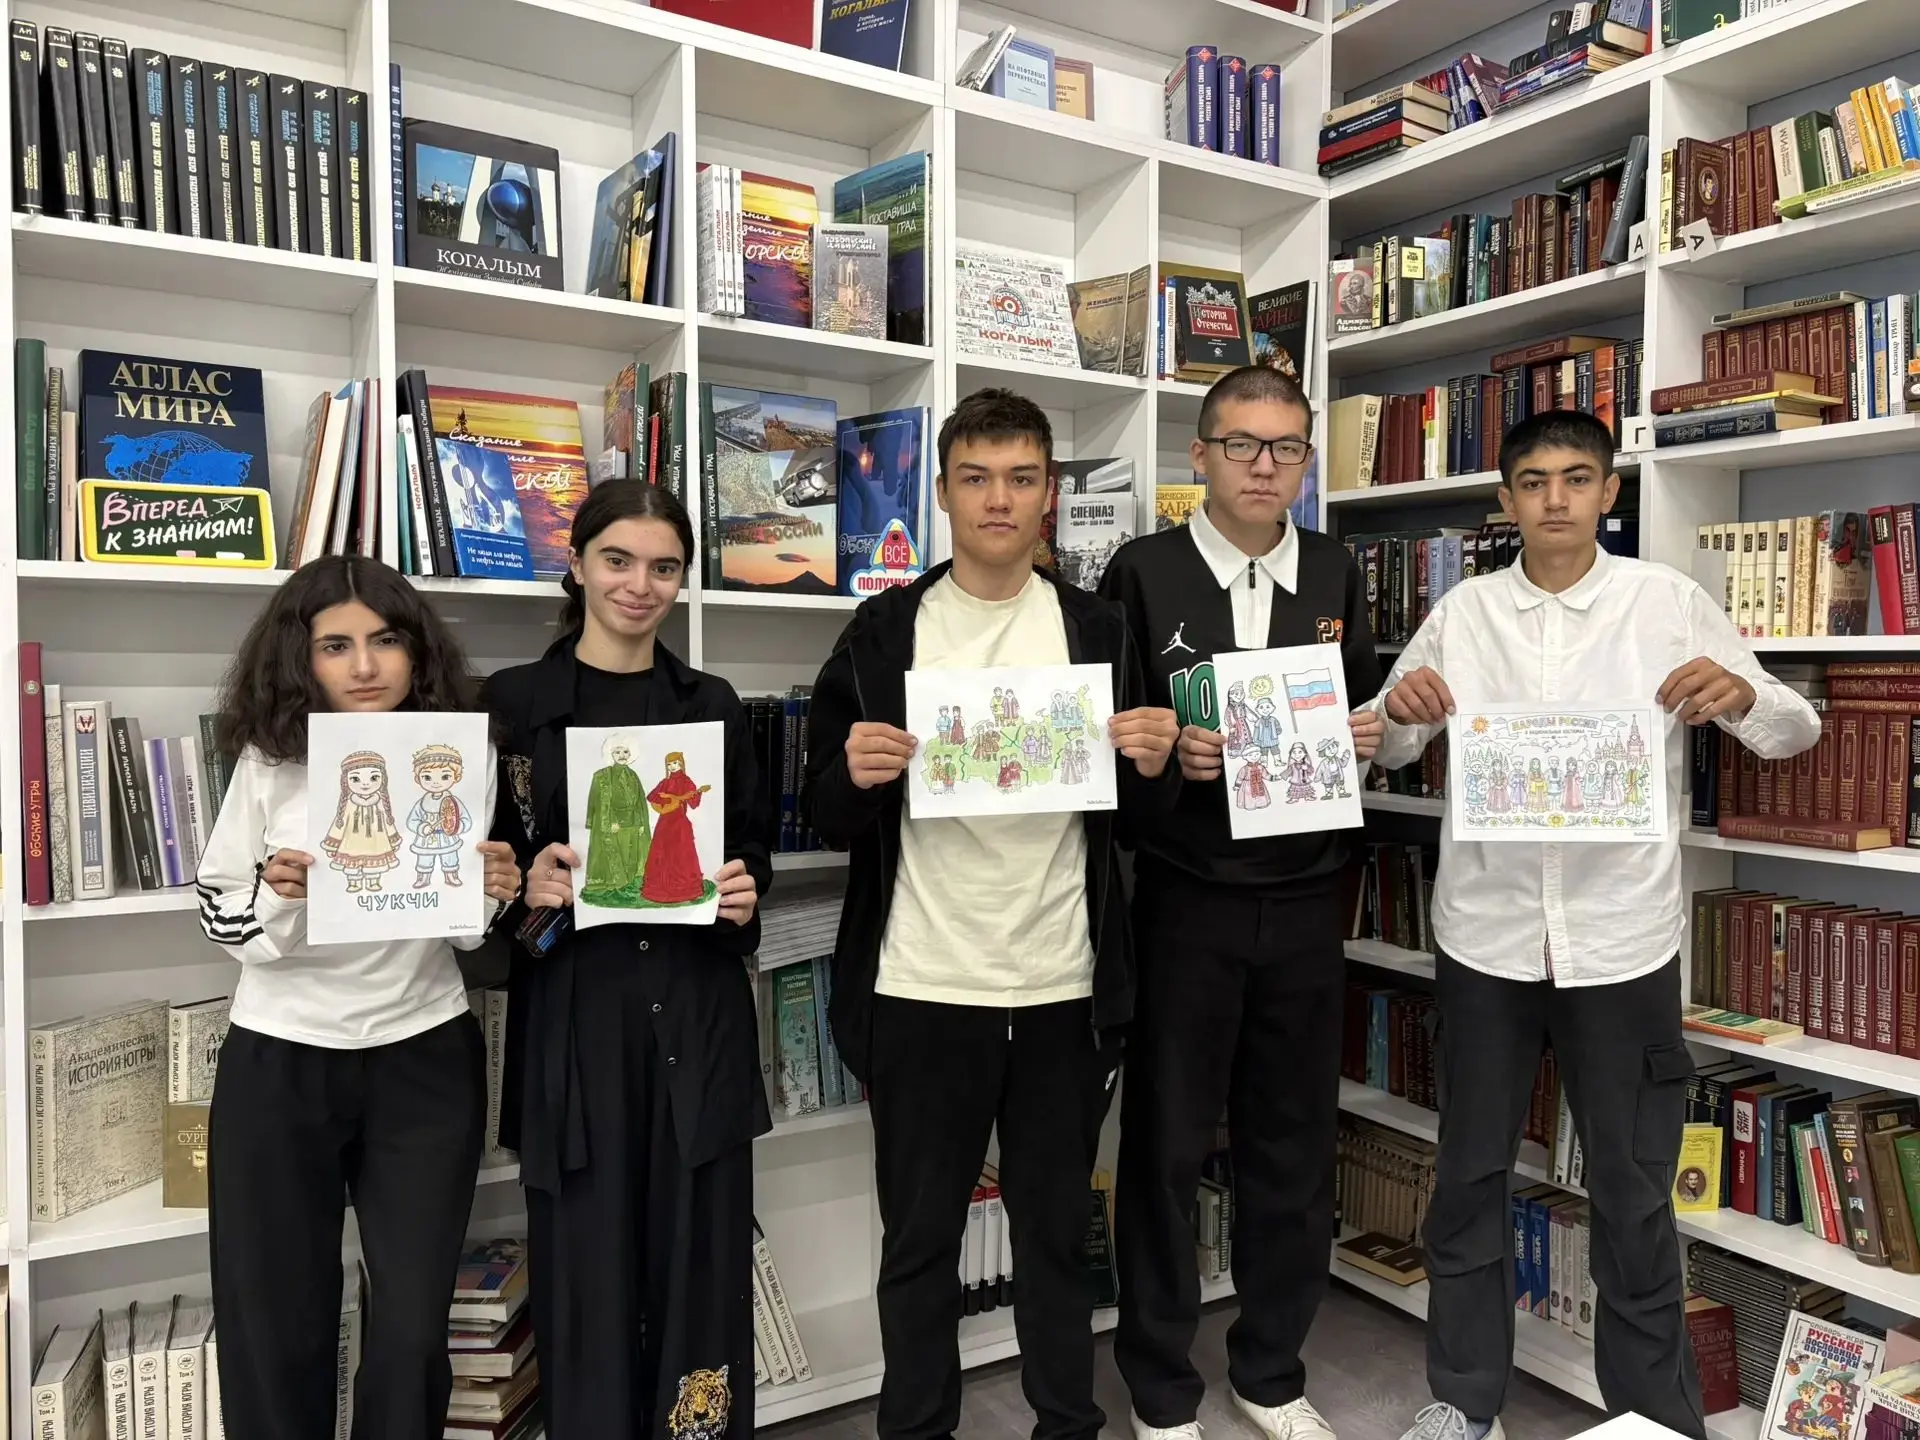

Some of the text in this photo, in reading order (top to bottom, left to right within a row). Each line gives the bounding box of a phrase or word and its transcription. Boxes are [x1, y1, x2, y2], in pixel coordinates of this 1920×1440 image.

[1634, 233, 1645, 252] А
[1690, 234, 1704, 251] А
[436, 248, 542, 279] КОГАЛЫМ
[1258, 289, 1304, 312] ВЕЛИКИЕ
[978, 329, 1053, 349] КОГАЛЫМ
[109, 360, 233, 397] АТЛАС
[115, 391, 237, 427] МИРА
[449, 428, 523, 449] Сказание
[1634, 426, 1647, 445] Г
[48, 436, 57, 480] КИЕВСКАЯ
[707, 453, 715, 472] ГРАД
[411, 463, 424, 511] КОГАЛЫМ
[1070, 505, 1114, 519] СПЕЦНАЗ
[104, 517, 255, 551] К ЗНАНИЯМ!
[466, 546, 476, 554] Не
[884, 542, 909, 565] ВСЁ
[1511, 716, 1599, 732] НАРОДЫ РОССИИ
[80, 748, 98, 819] ЦИВИЛИЗАЦИИ
[357, 891, 440, 912] ЧУКЧИ
[68, 1030, 156, 1067] Академическая
[35, 1064, 44, 1085] ЮГРЫ
[67, 1046, 157, 1087] ИСТОРИЯ ЮГРЫ
[36, 1086, 44, 1118] ИСТОРИЯ
[177, 1132, 208, 1144] СУРГ
[1805, 1337, 1861, 1362] ПОСЛОВИЦЫ
[1808, 1328, 1864, 1355] РУССКИЕ
[1804, 1344, 1860, 1370] ПОГОВОРКИ
[144, 1386, 155, 1408] ЮГРЫ
[182, 1382, 192, 1404] ЮГРЫ
[1890, 1395, 1920, 1414] УЛЬТУРА
[1900, 1406, 1920, 1420] СКИЙ
[115, 1392, 128, 1440] СТОРИЯ ЮГРЫ
